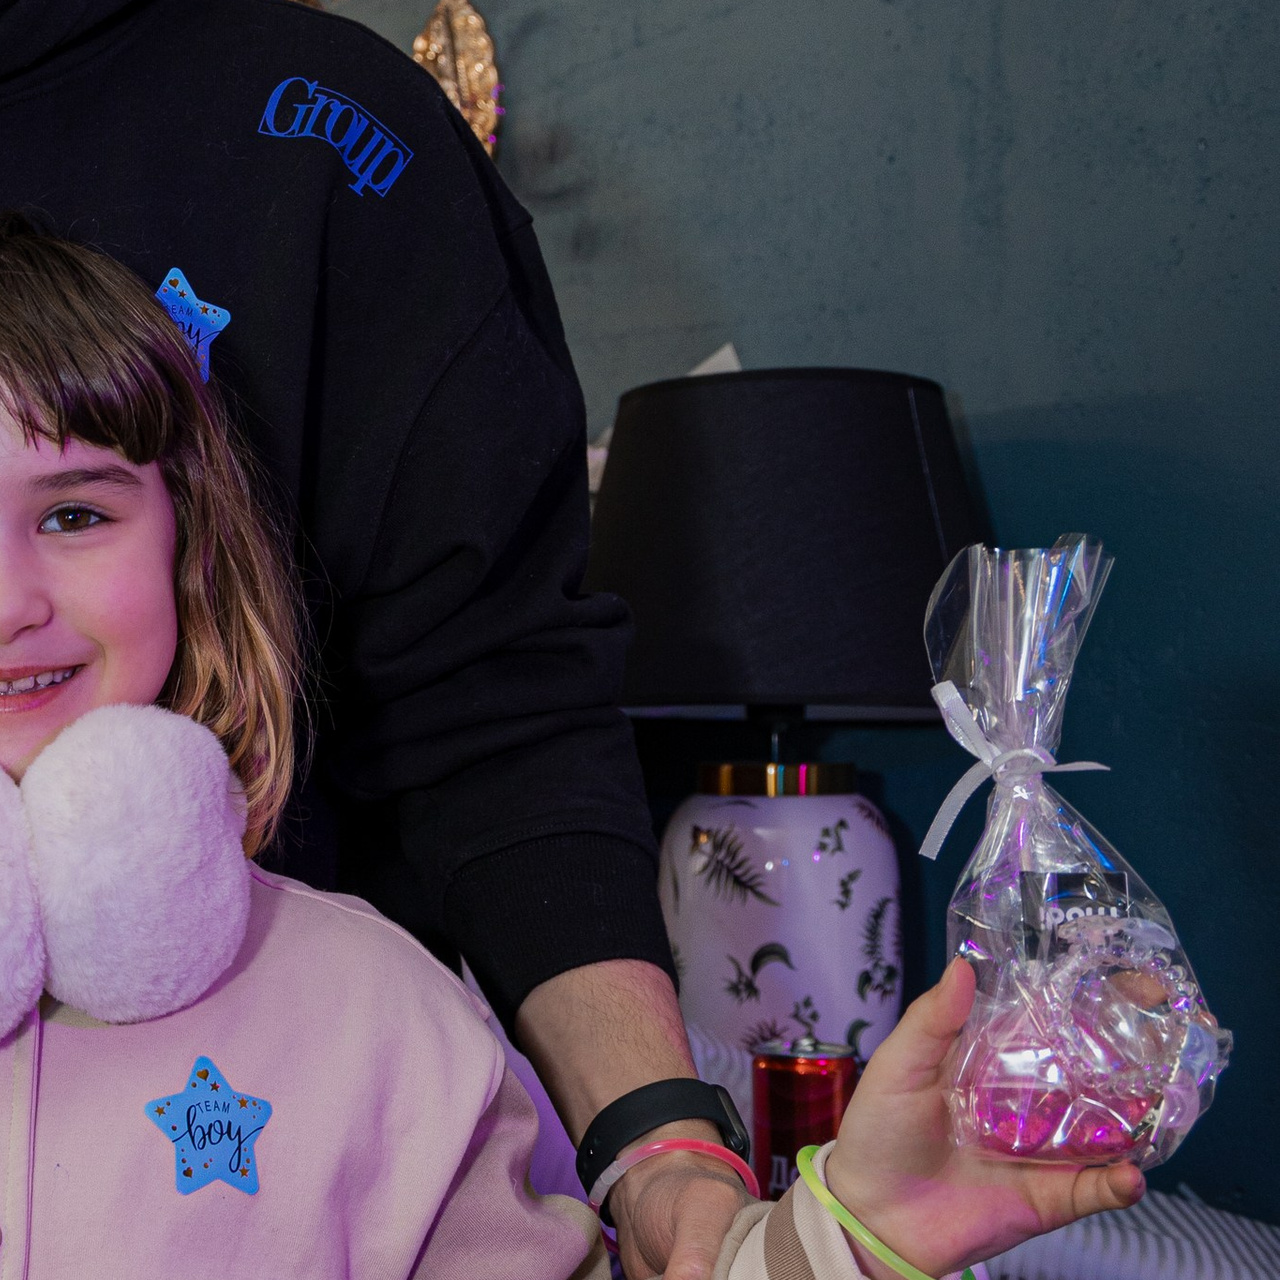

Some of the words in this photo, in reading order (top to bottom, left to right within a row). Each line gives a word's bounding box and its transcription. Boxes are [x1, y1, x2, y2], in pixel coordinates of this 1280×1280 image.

[265, 76, 406, 197] Group
[166, 304, 194, 317] EAM
[195, 1100, 231, 1114] TEAM
[172, 1104, 265, 1173] boy
